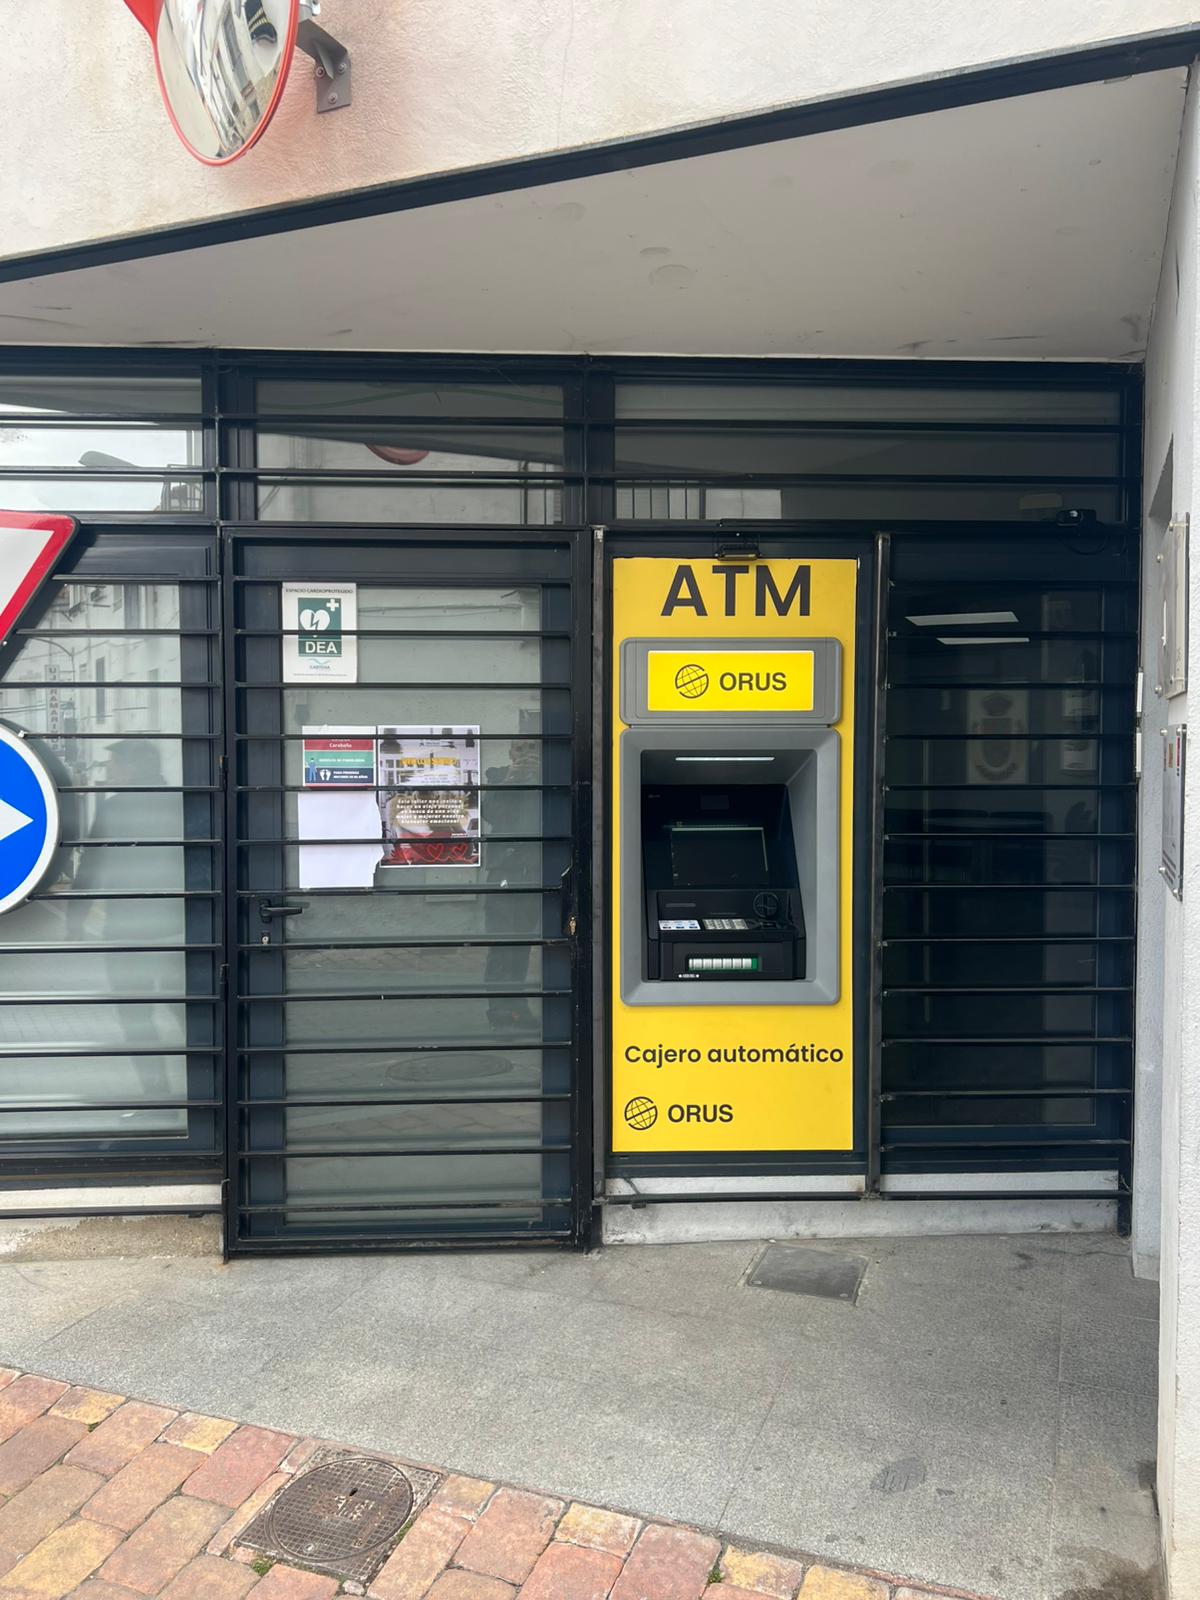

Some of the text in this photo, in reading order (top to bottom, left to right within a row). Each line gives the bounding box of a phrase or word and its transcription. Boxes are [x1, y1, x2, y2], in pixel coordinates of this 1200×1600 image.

[660, 564, 812, 617] ATM
[305, 641, 338, 654] DEA
[719, 672, 787, 691] ORUS
[624, 1043, 844, 1068] Cajero automático
[667, 1104, 734, 1123] ORUS
